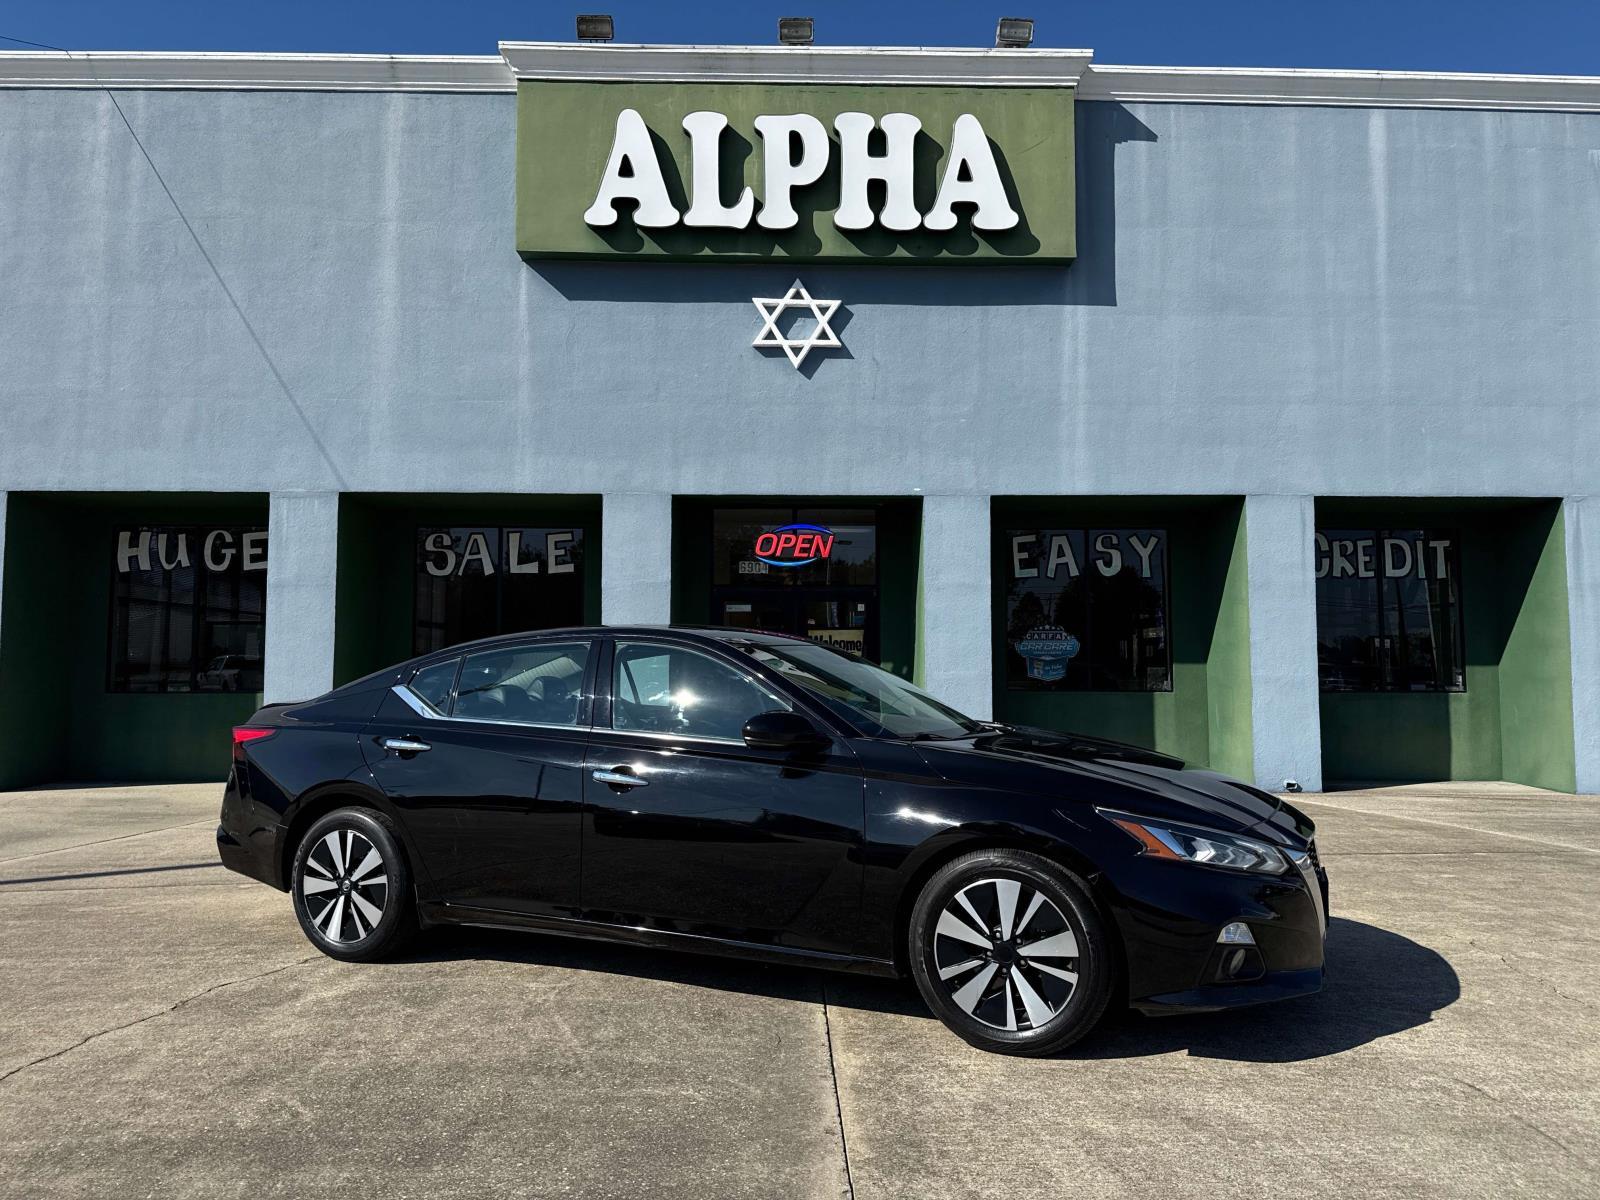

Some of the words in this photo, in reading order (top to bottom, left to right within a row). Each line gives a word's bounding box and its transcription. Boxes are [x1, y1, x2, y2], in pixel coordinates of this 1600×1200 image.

[584, 109, 1019, 230] ALPHA
[117, 530, 268, 573] HUGE
[424, 532, 575, 576] SALE
[755, 533, 834, 557] OPEN
[1013, 535, 1158, 577] EASY
[1315, 532, 1449, 578] CREDIT
[740, 562, 768, 573] 6904
[1020, 642, 1043, 650] CAR
[1044, 642, 1074, 651] CARE
